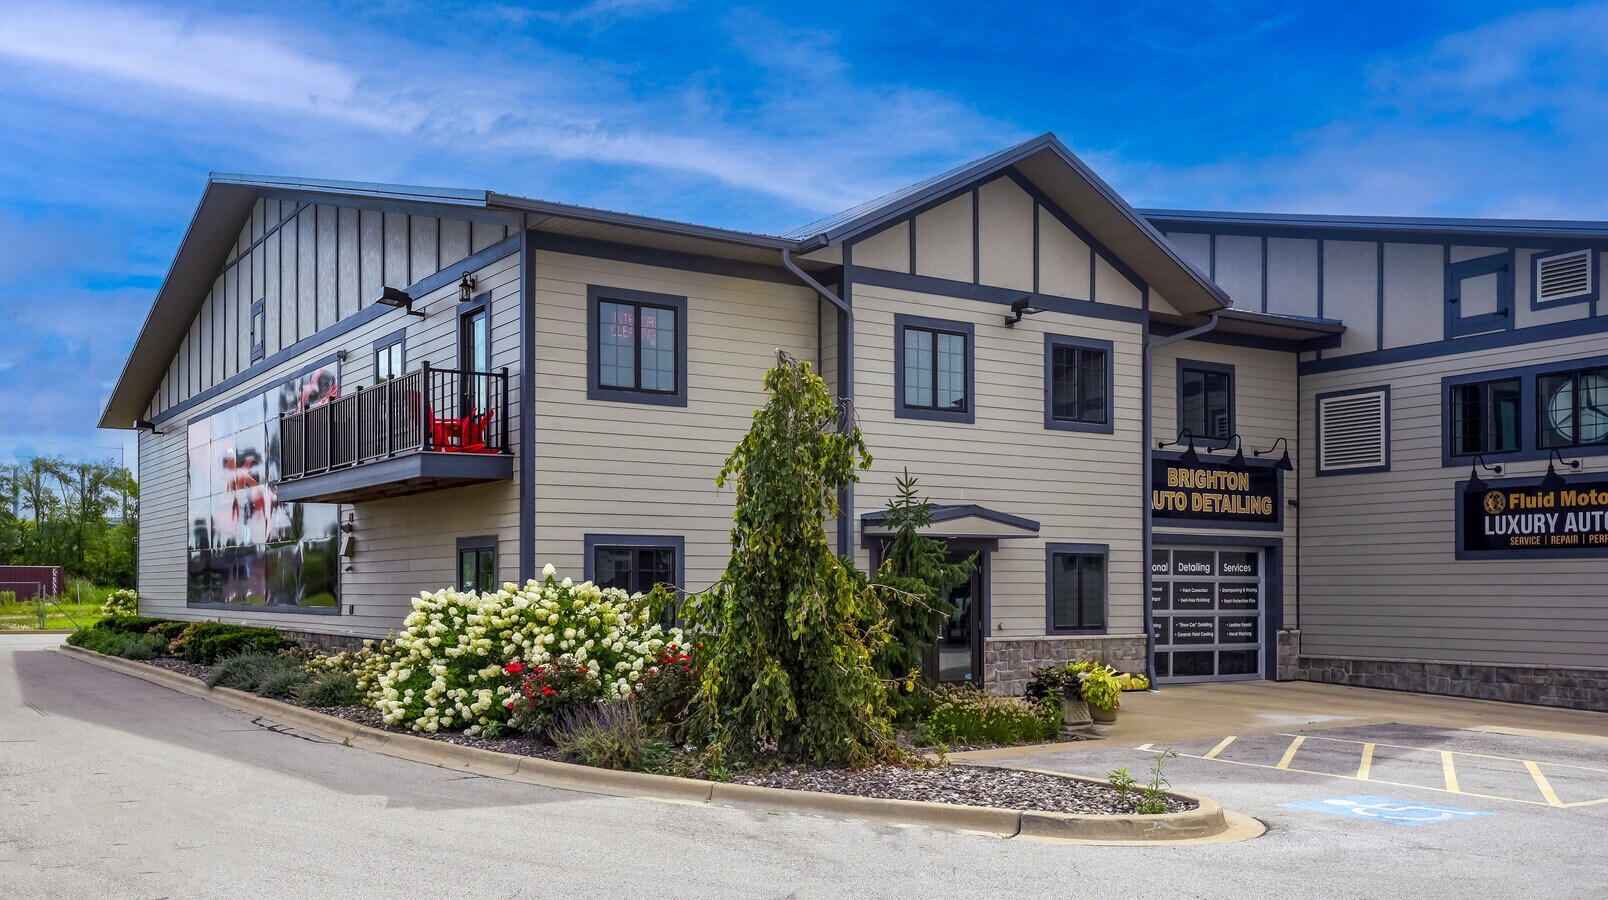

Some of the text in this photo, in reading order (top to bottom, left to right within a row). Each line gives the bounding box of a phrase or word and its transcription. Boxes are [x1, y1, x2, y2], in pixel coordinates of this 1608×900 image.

[611, 311, 656, 329] INTEOR
[611, 324, 656, 340] CLENG
[1167, 467, 1249, 491] BRIGHTON
[1152, 490, 1272, 515] UTO DETAILING
[1509, 489, 1608, 509] Fluid Moto
[1484, 513, 1559, 535] LUXURY
[1510, 536, 1541, 546] SERVICE
[1550, 534, 1579, 545] REPAIR
[1178, 562, 1211, 574] Detailing
[1223, 563, 1252, 572] Services
